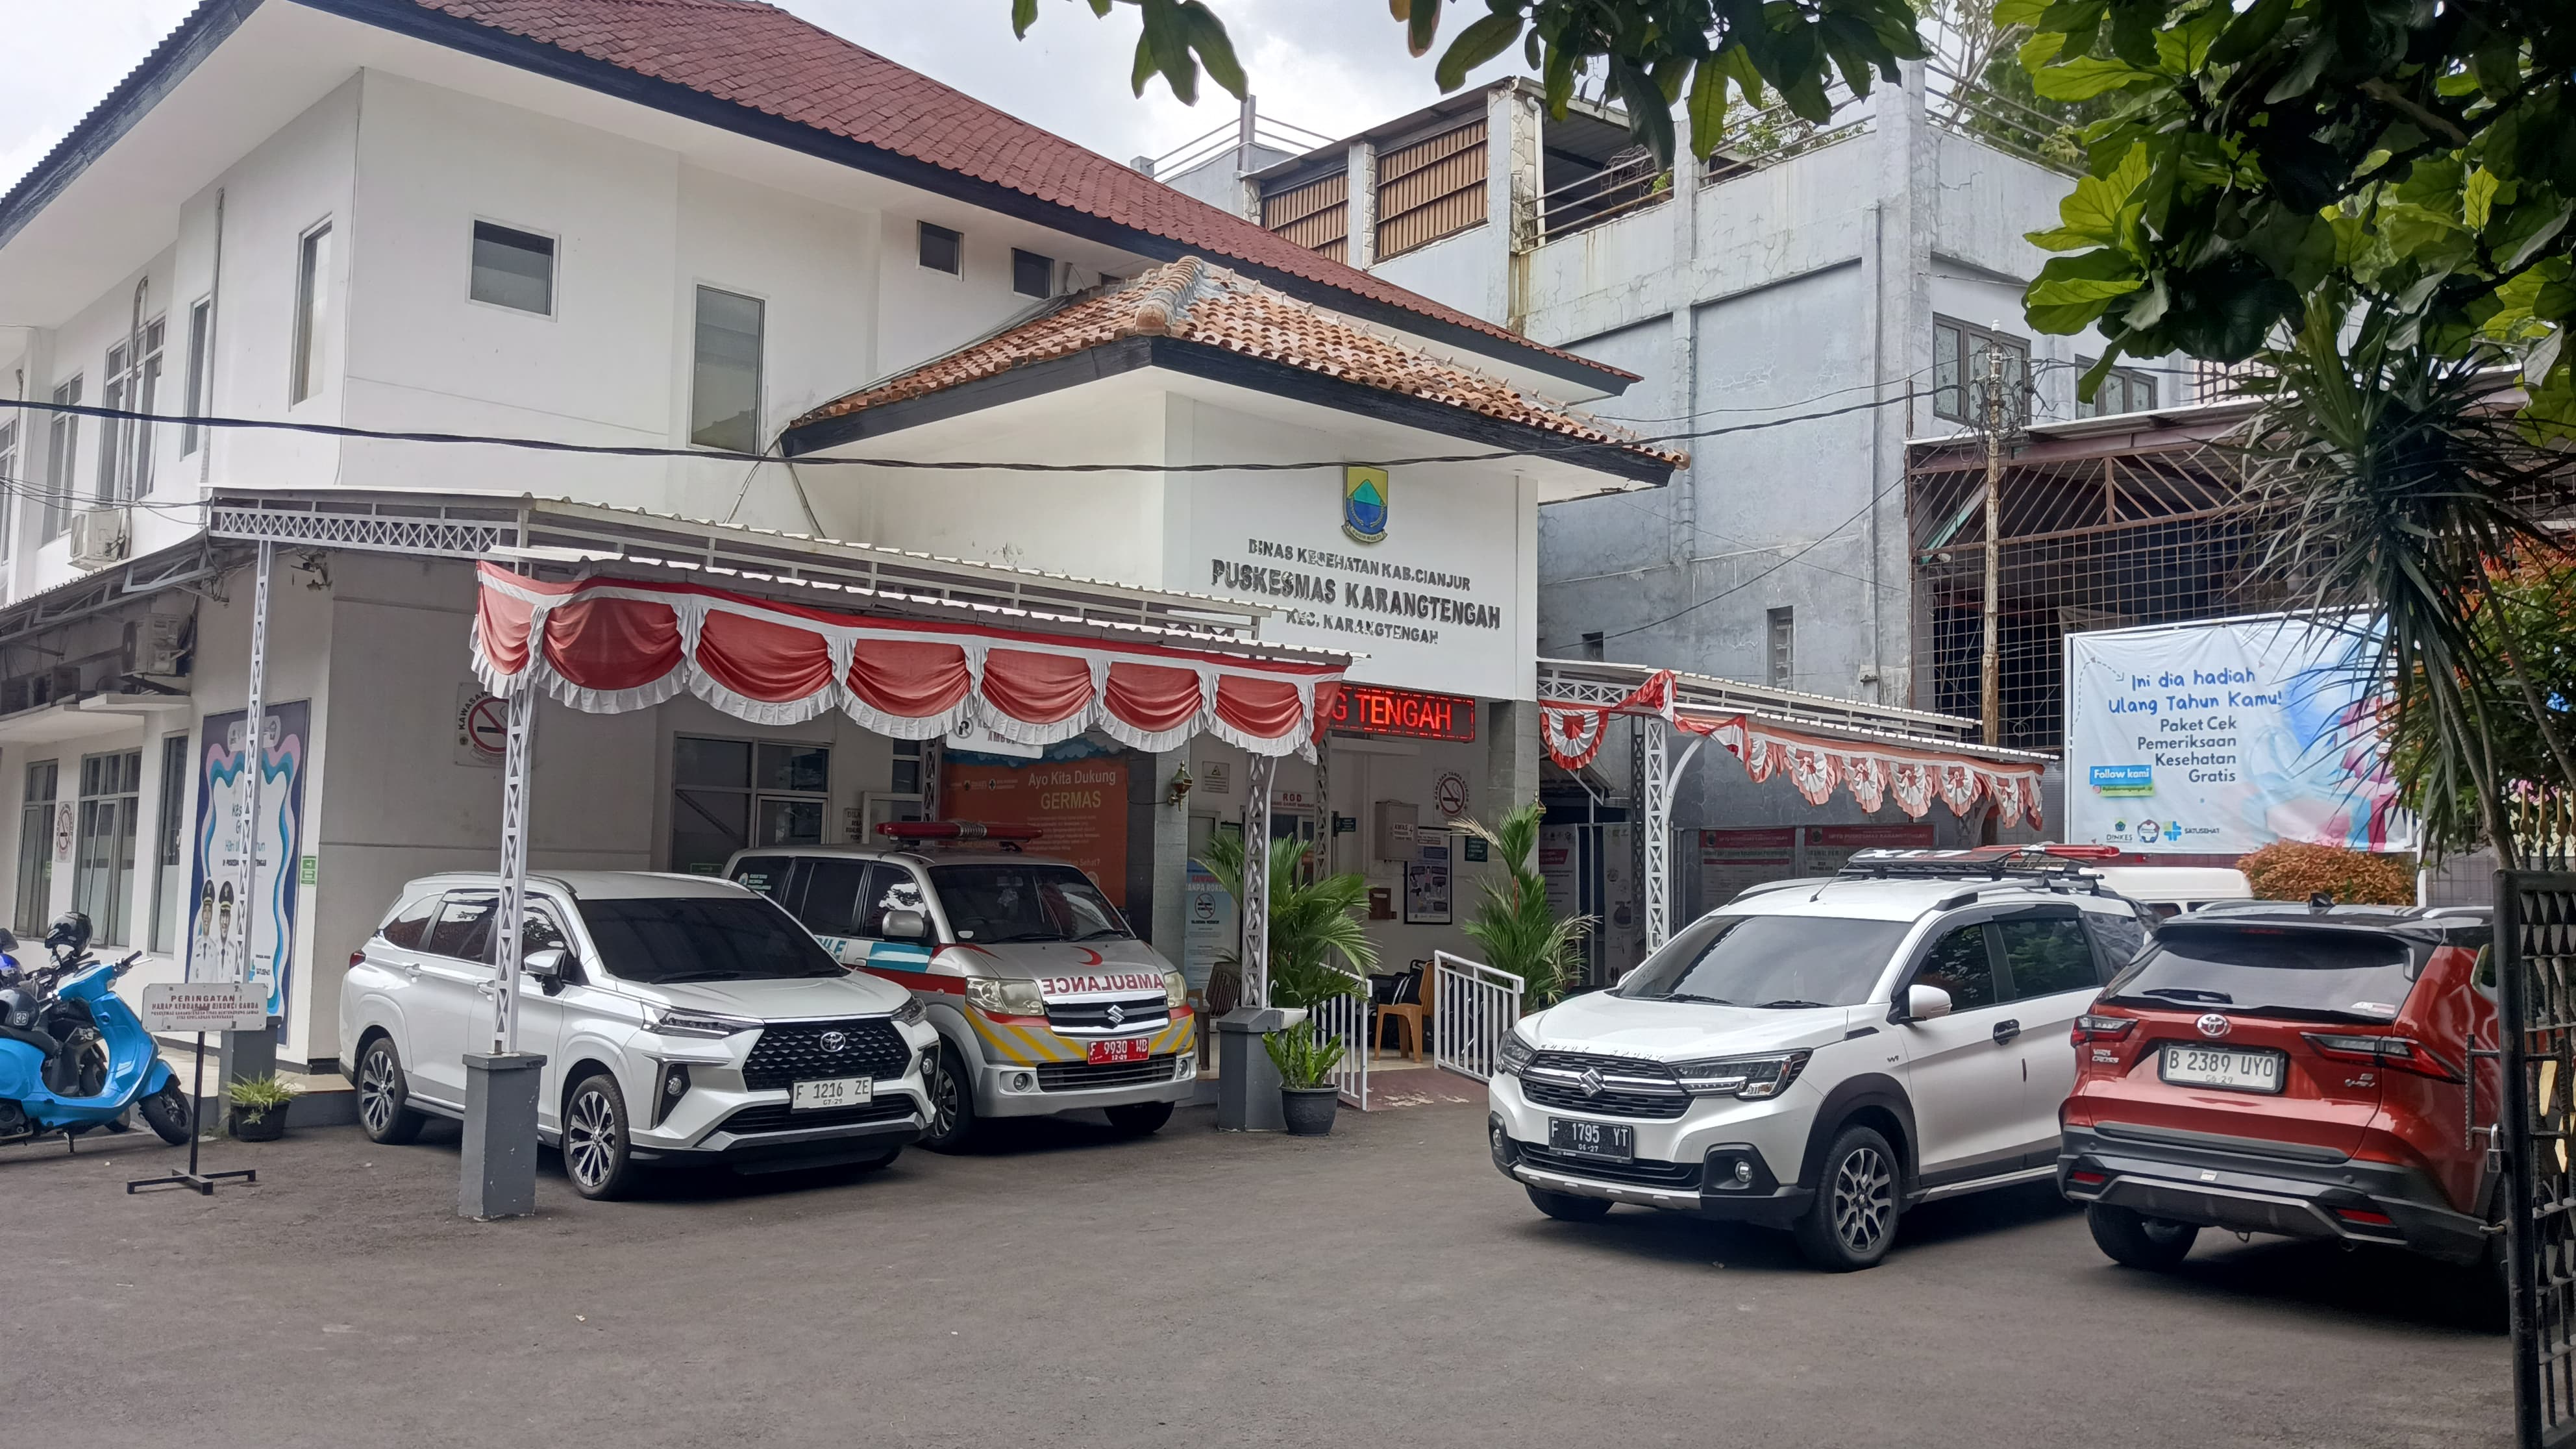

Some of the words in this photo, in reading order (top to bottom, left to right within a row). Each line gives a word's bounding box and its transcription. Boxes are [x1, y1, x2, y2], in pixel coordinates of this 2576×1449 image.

[1248, 538, 1293, 560] DINAS
[1298, 547, 1380, 576] KESEHATAN
[1211, 559, 1336, 604] PUSKESMAS
[1345, 582, 1501, 629] KARANGTENGAH
[1323, 613, 1439, 644] KARANGTENGAH
[2132, 674, 2150, 691] Ini
[2159, 671, 2185, 688] dia
[2193, 667, 2256, 684] hadiah
[1354, 693, 1452, 730] TENGAH
[2108, 697, 2157, 715] Ulang
[2166, 694, 2220, 710] Tahun
[2228, 690, 2283, 708] Kamu!
[2160, 718, 2203, 732] Paket
[2207, 716, 2237, 730] Cek
[2137, 735, 2237, 750] Pemeriksaan
[2155, 752, 2237, 767] Kesehatan
[1028, 773, 1048, 789] Ayo
[1052, 771, 1072, 786] Kita
[1074, 770, 1117, 786] Dukung
[2094, 769, 2125, 779] Follow
[2127, 768, 2150, 778] kami
[2188, 768, 2236, 783] Gratis
[1041, 791, 1102, 810] GERMAS
[1090, 1042, 1096, 1056] F
[1104, 1040, 1128, 1055] 9930
[2170, 1050, 2179, 1070] B
[2186, 1052, 2231, 1073] 2389
[2240, 1056, 2274, 1077] UYO
[796, 1085, 803, 1100] F
[813, 1082, 843, 1099] 1216
[854, 1080, 869, 1095] ZE
[1551, 1120, 1559, 1138] F
[1572, 1123, 1600, 1143] 1795
[1613, 1127, 1628, 1147] YT
